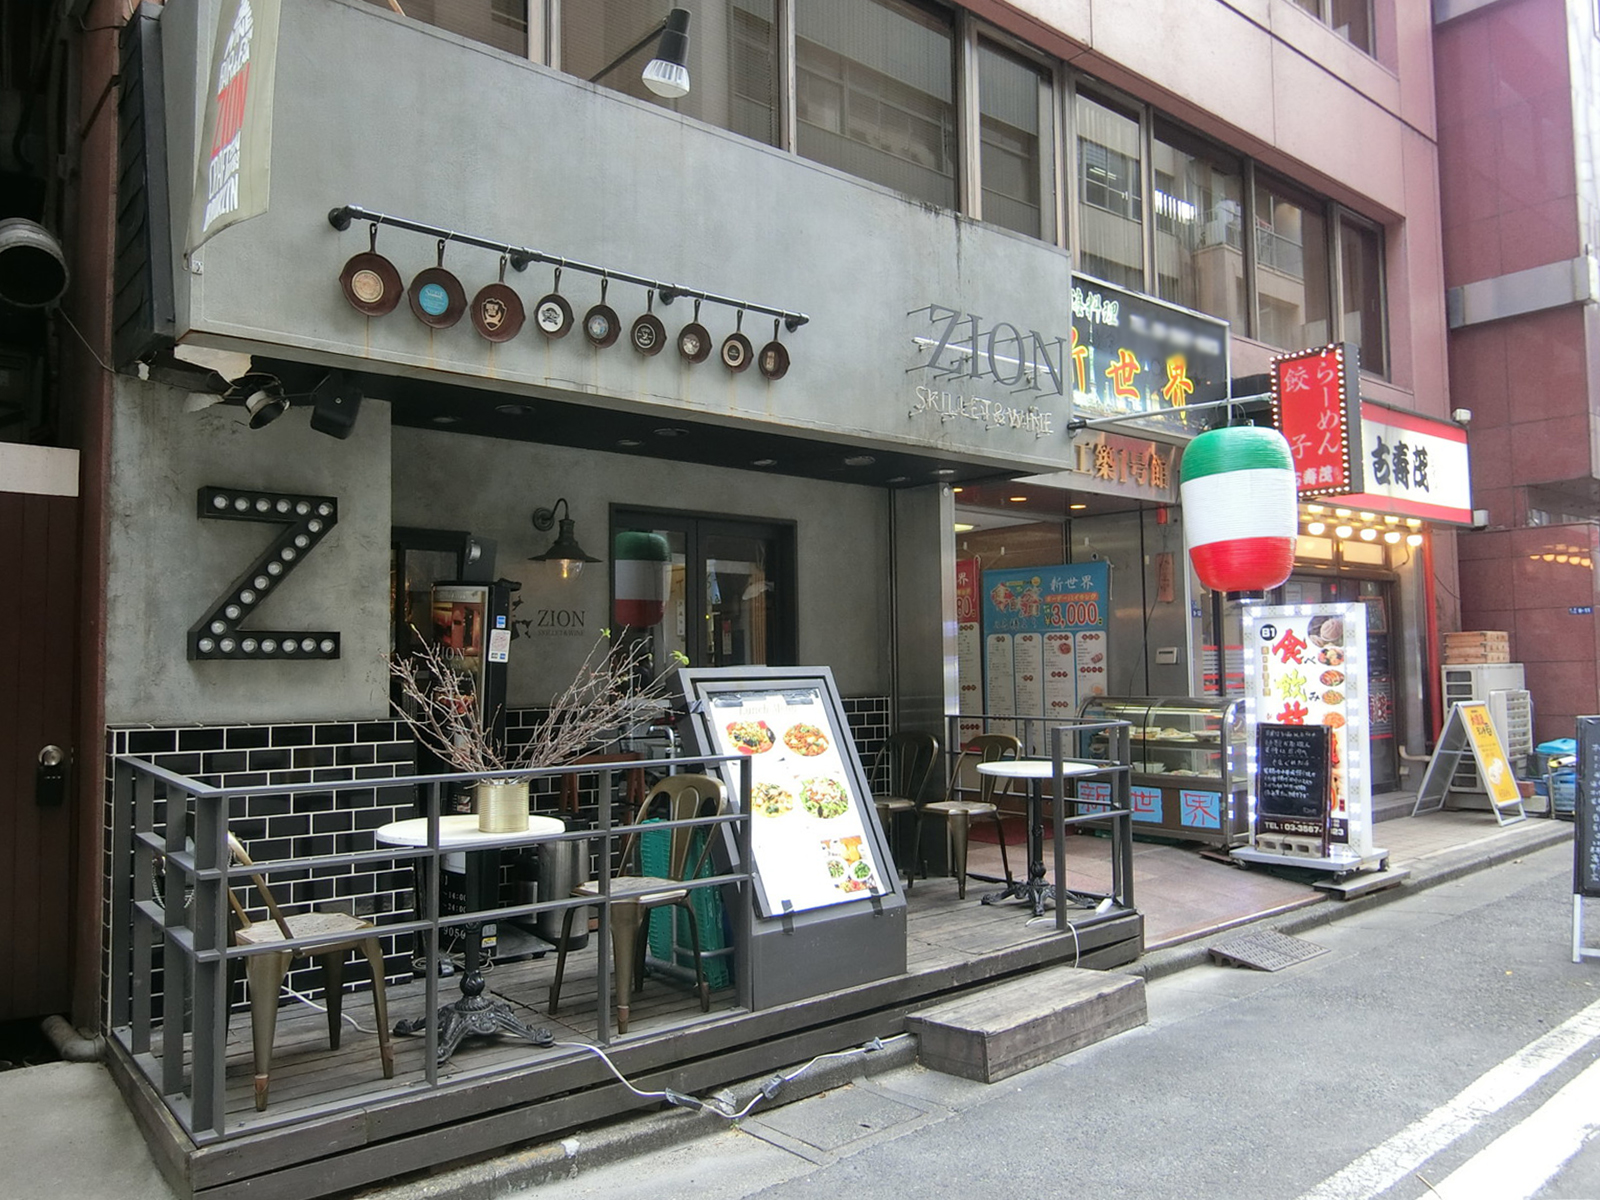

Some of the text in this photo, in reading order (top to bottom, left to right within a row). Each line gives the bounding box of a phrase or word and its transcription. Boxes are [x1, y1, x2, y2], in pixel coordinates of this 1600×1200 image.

[212, 62, 250, 158] ZION
[930, 303, 1067, 396] ZION
[1317, 361, 1340, 455] らーめん
[187, 486, 340, 660] Z
[538, 609, 585, 627] ZION
[1051, 575, 1093, 591] 新世界
[1261, 628, 1276, 638] B1
